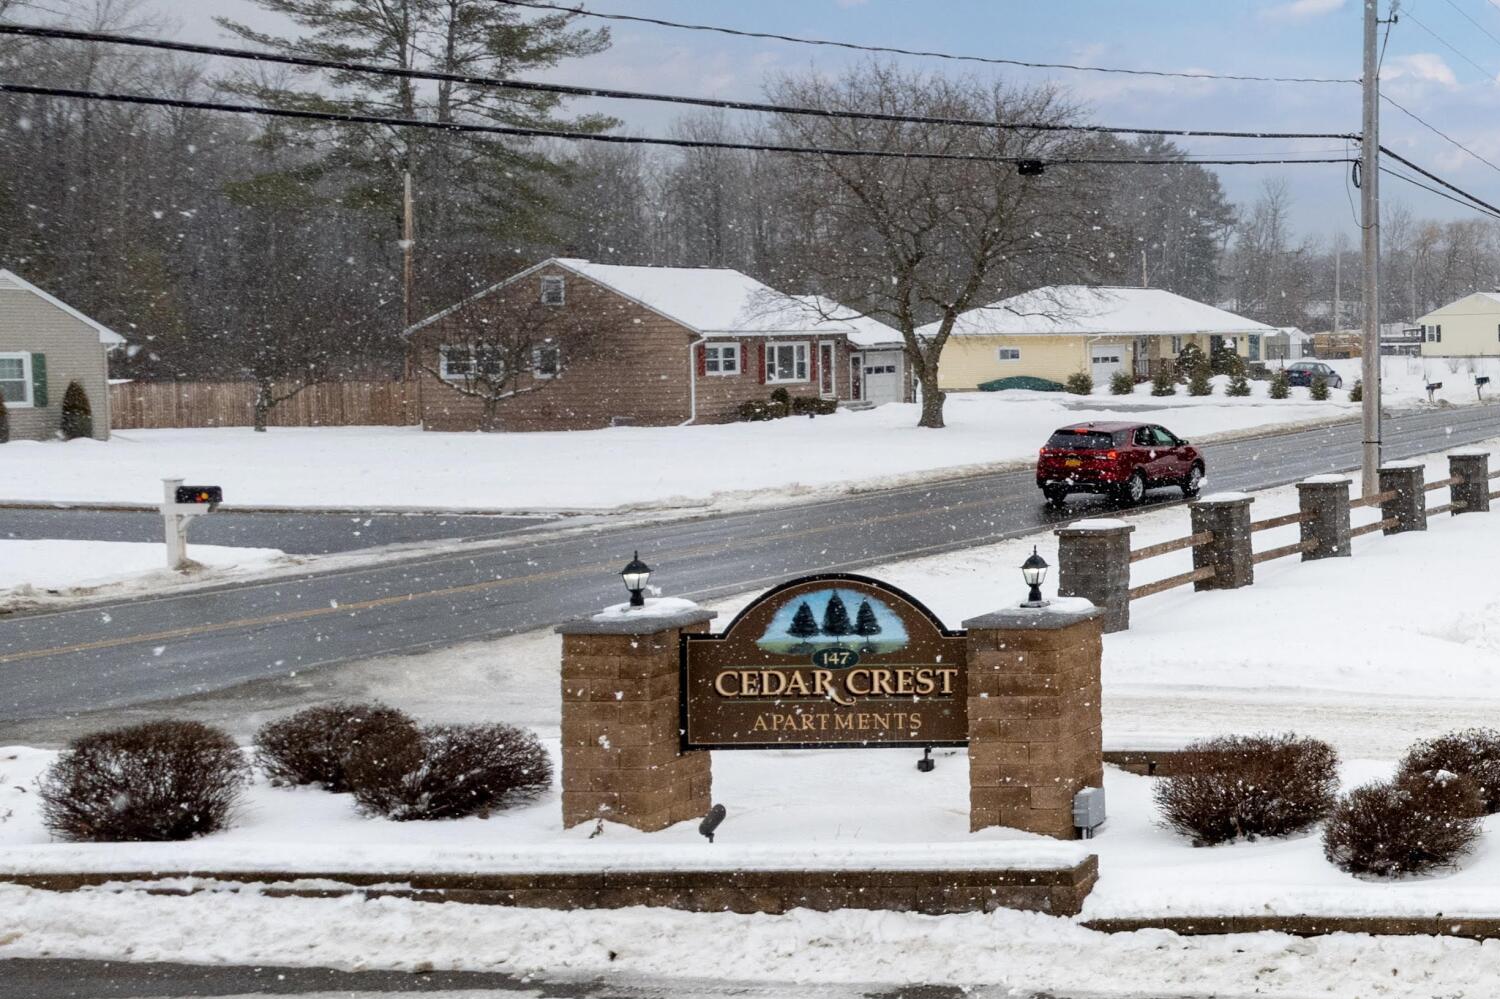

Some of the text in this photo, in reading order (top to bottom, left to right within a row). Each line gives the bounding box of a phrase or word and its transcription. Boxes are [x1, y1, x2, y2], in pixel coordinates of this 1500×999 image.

[822, 651, 851, 665] 147
[714, 668, 958, 706] CEDAR CREST
[753, 712, 923, 732] APARTMENTS
